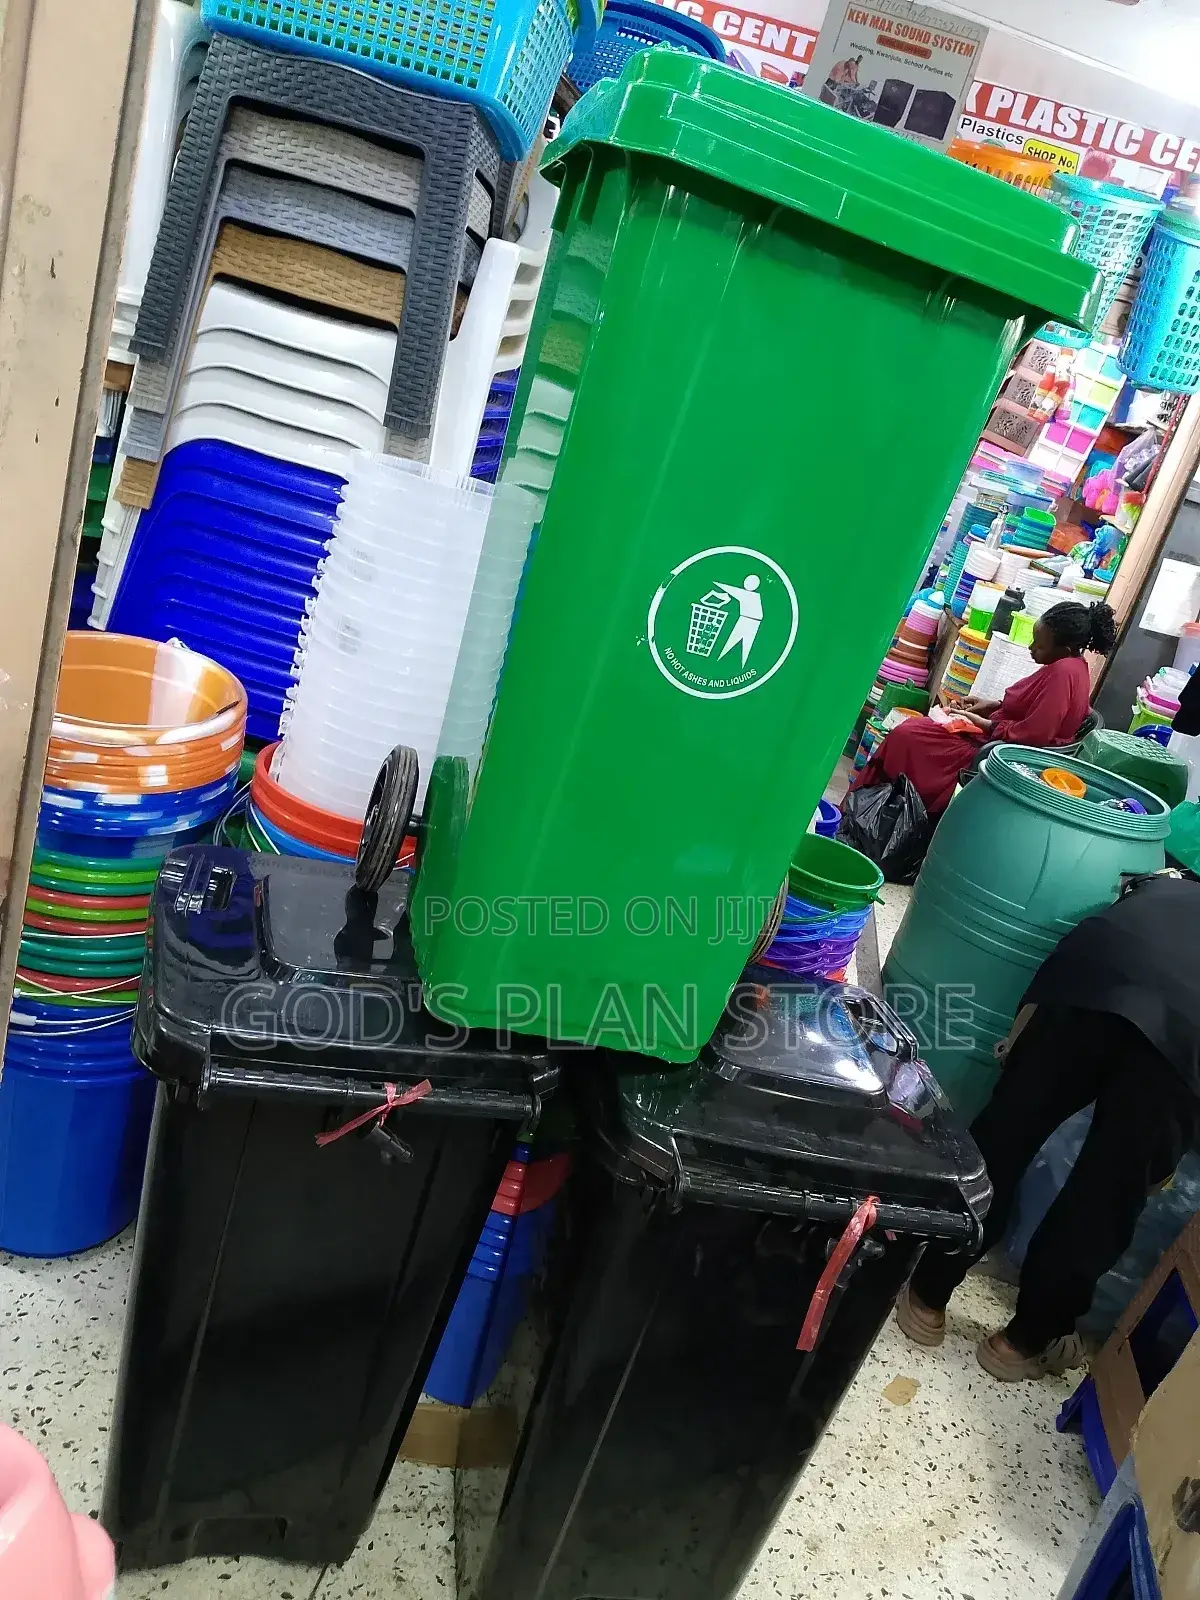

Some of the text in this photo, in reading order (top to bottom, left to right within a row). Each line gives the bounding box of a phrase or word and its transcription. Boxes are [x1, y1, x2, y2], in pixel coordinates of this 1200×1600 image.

[713, 11, 816, 58] CENT
[847, 8, 869, 26] KEN
[869, 14, 895, 34] MAX
[894, 22, 931, 46] SOUND
[931, 35, 976, 58] SYSTEM
[903, 58, 924, 70] School
[923, 64, 944, 76] Parties
[944, 71, 954, 79] etc
[960, 117, 1024, 146] Plastics
[984, 85, 1145, 157] PLASTIC
[1149, 133, 1200, 174] CE
[1026, 146, 1075, 170] SHOP No.
[664, 647, 757, 688] NO HOT ASHES AND LIQUIDS
